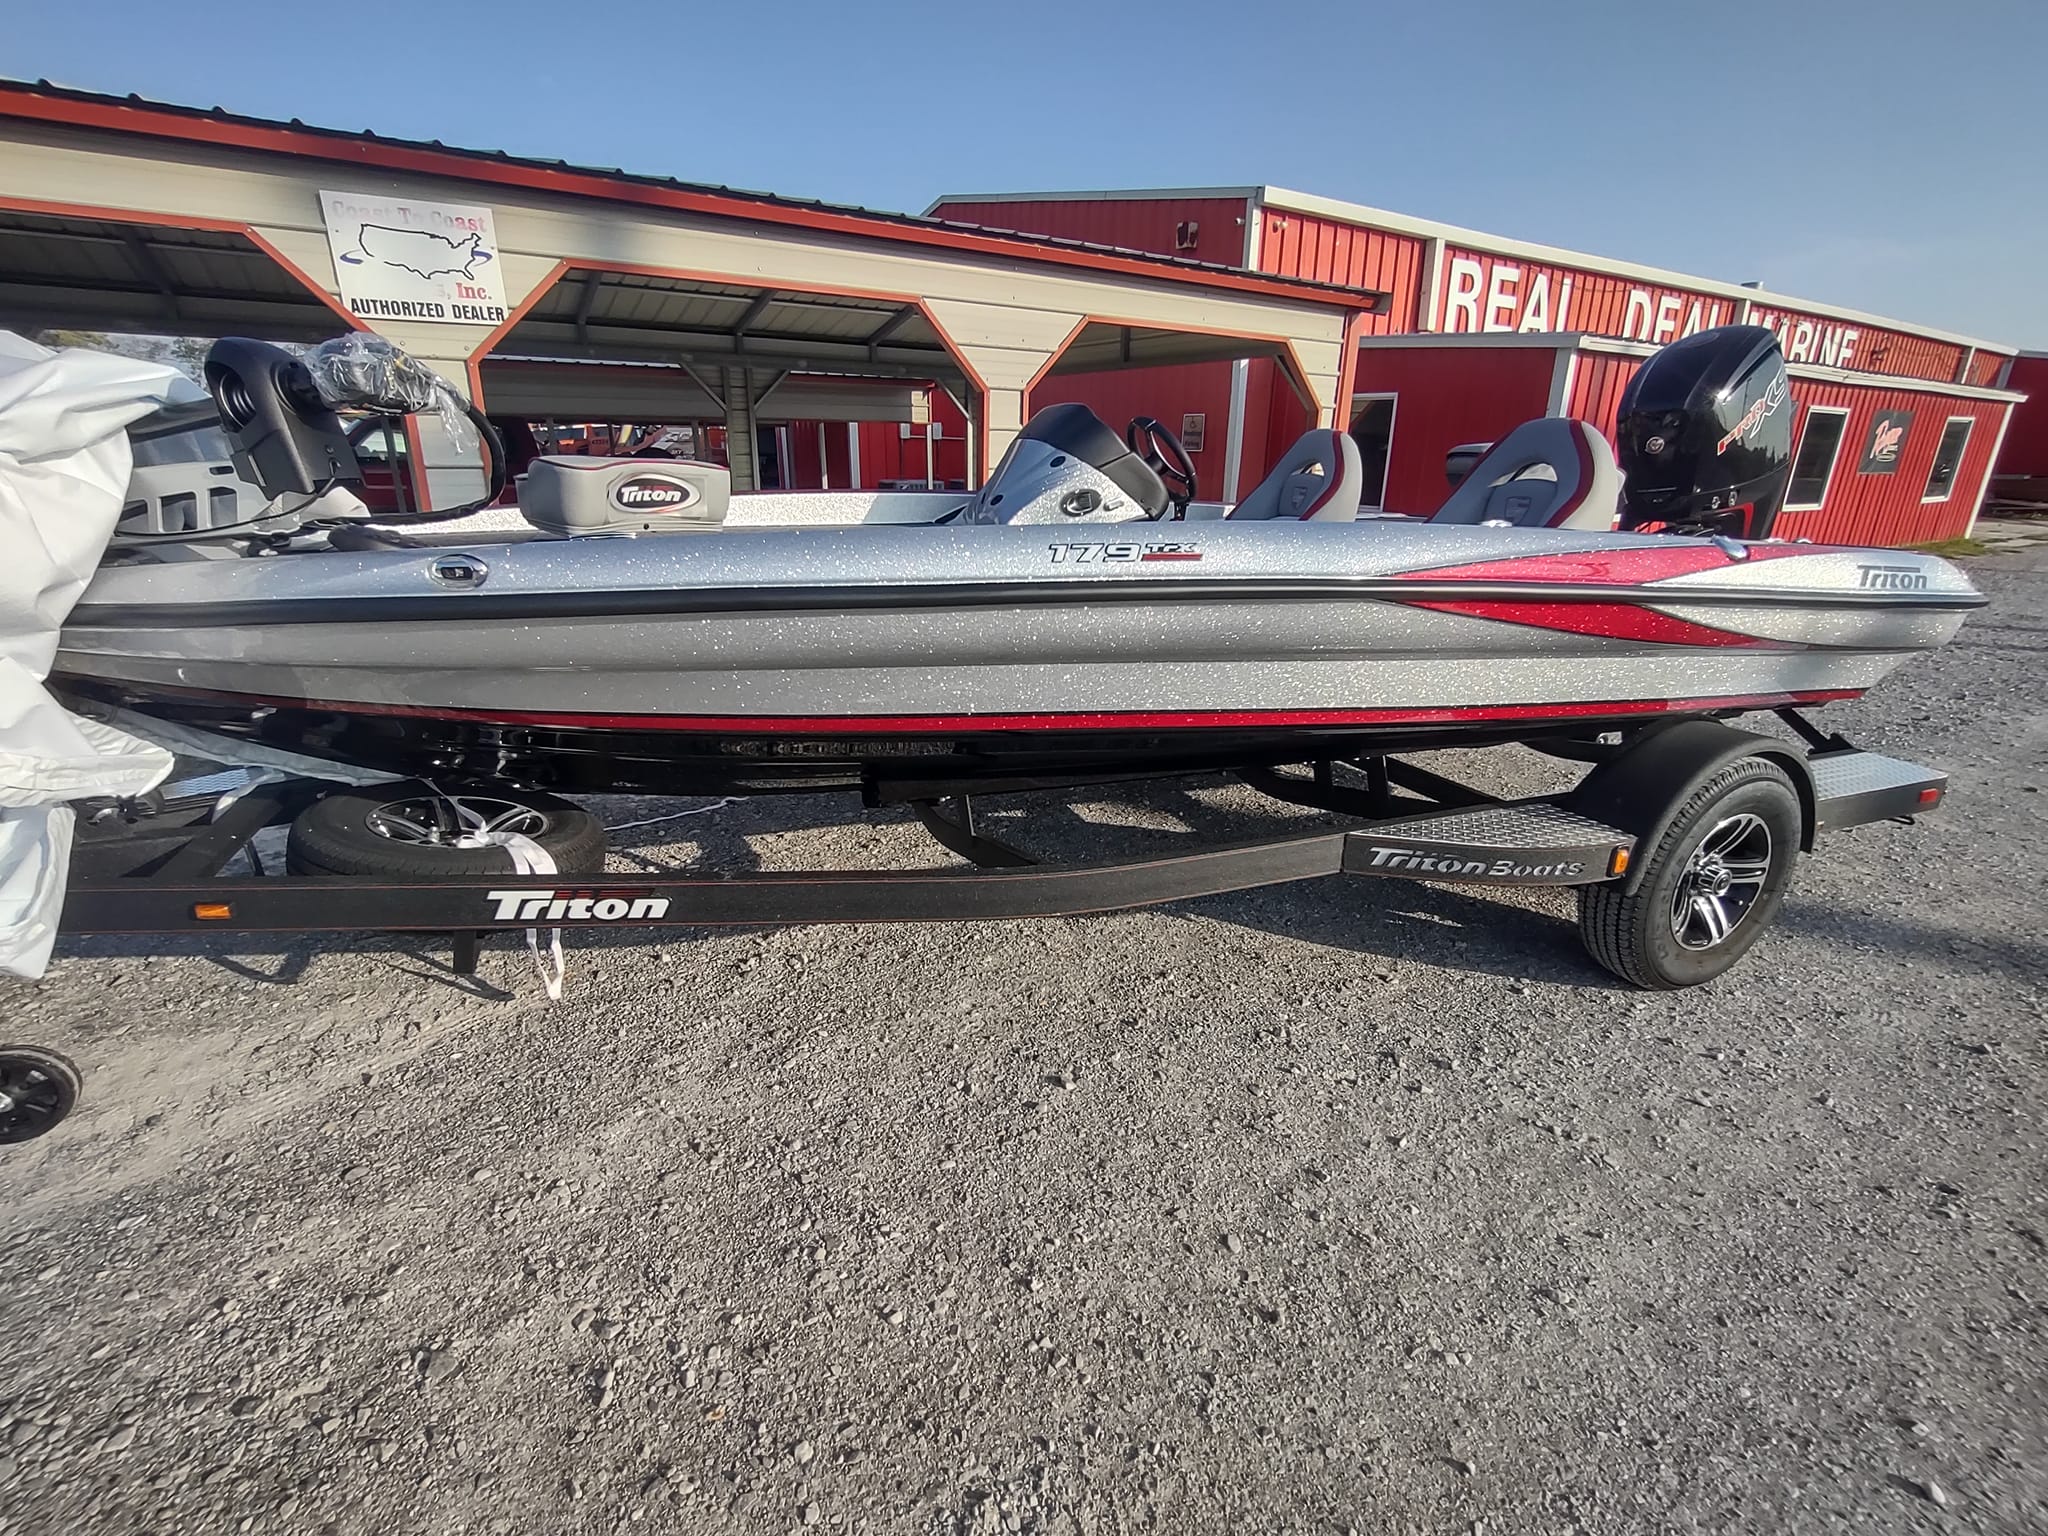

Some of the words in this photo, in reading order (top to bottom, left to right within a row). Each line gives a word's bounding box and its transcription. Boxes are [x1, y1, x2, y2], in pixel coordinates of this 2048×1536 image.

[429, 210, 487, 233] Coast
[456, 283, 492, 301] Inc.
[1444, 257, 1571, 334] REAL
[351, 298, 444, 319] AUTHORIZED
[452, 304, 505, 322] DEALER
[621, 485, 682, 503] Triton
[1049, 542, 1142, 563] 179
[1857, 564, 1928, 590] Triton
[486, 890, 671, 921] Triton
